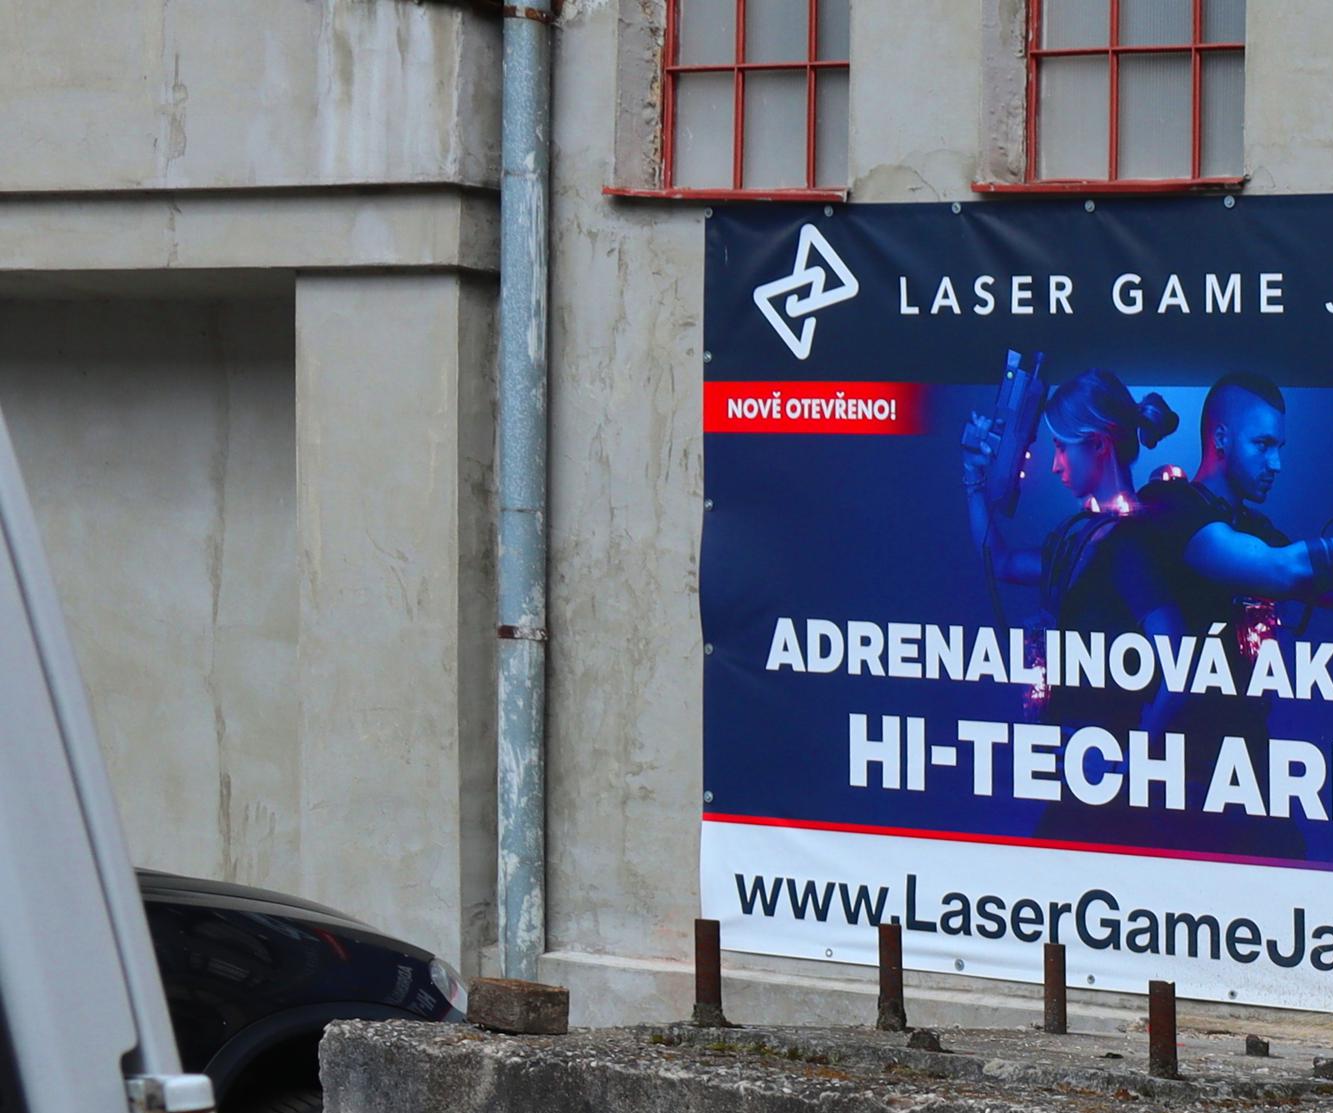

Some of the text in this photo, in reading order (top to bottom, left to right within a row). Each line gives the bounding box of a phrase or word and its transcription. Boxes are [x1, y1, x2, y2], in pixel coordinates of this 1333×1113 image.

[901, 275, 1073, 315] LASER
[1112, 273, 1284, 314] GAME
[728, 391, 896, 420] NOVĚ OTEVŘENO!
[765, 618, 1237, 698] ADRENALINOVÁ
[848, 713, 1187, 811] HI-TECH
